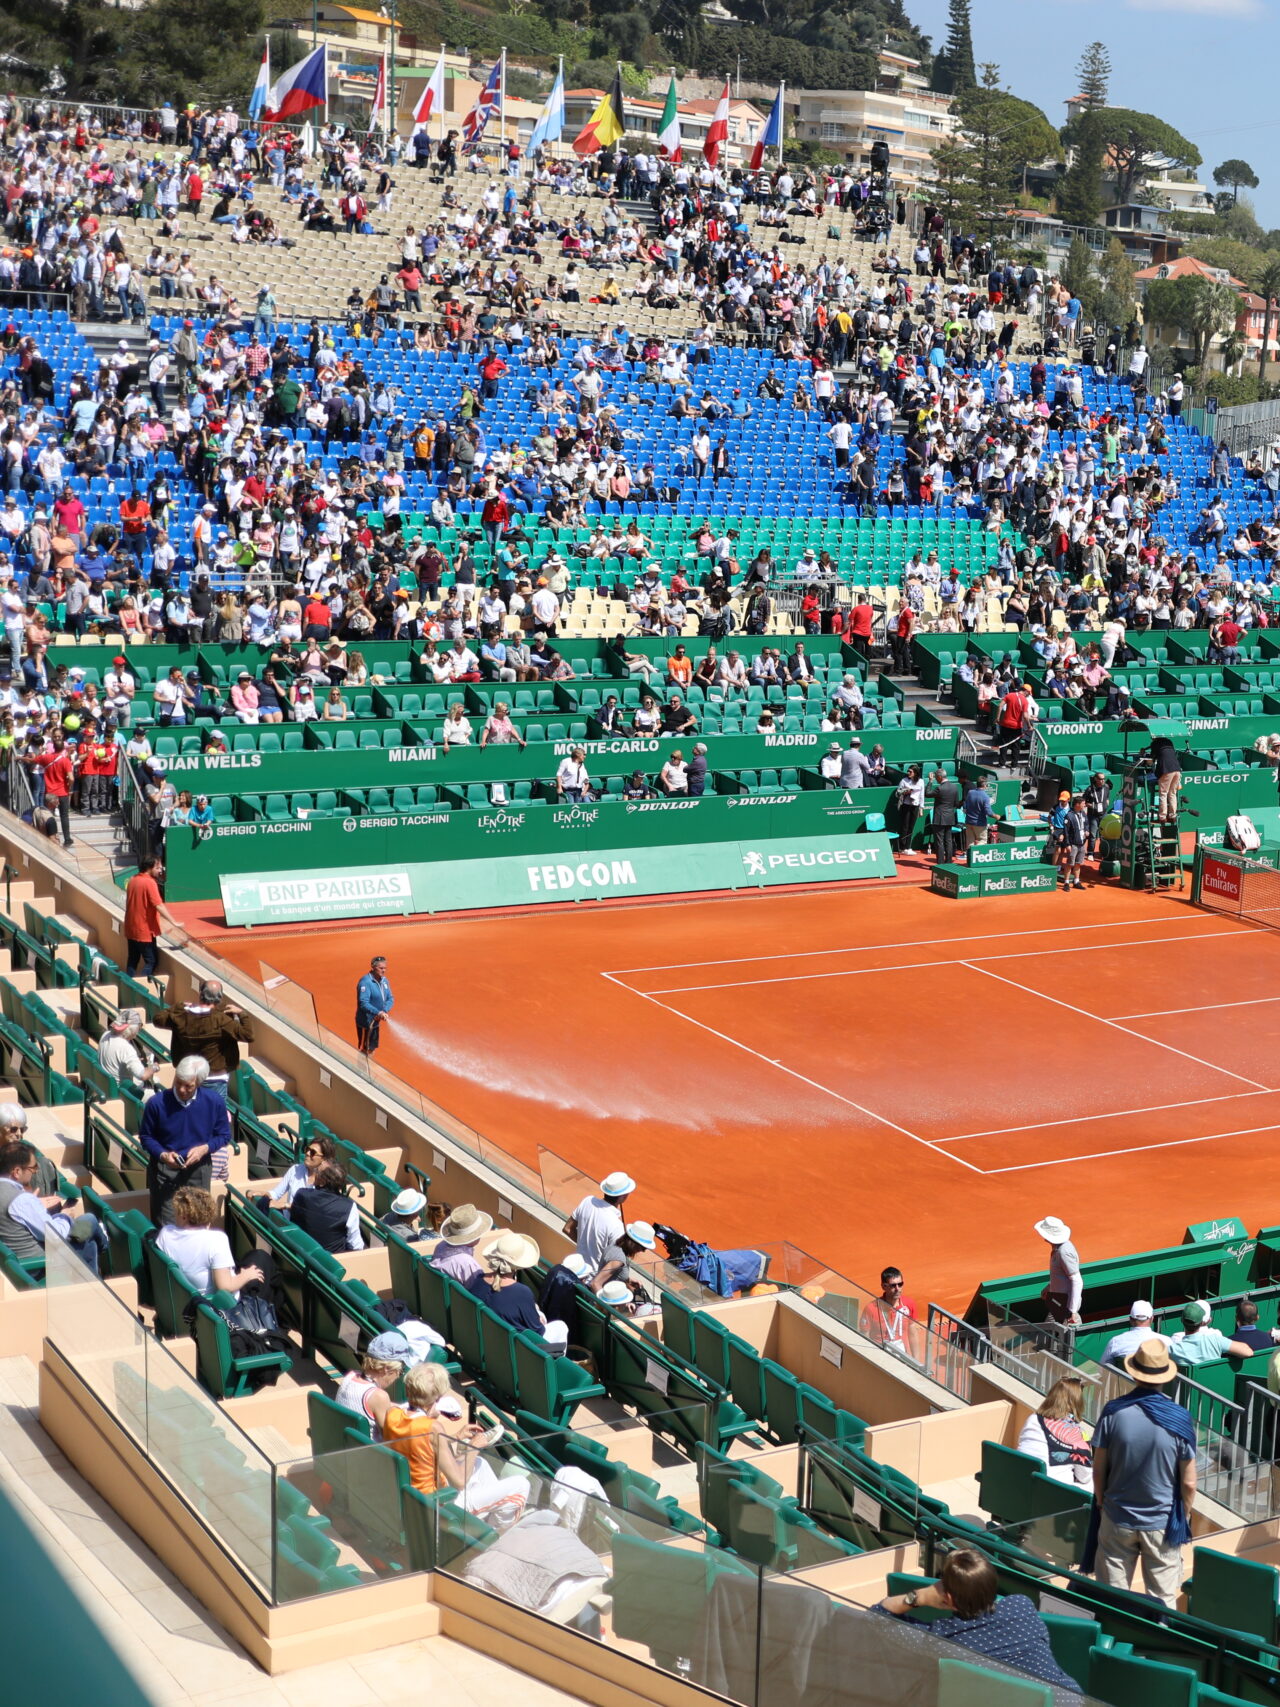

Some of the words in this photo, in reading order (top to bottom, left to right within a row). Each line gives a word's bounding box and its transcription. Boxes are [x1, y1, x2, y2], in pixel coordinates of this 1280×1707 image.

[1208, 401, 1216, 413] K
[916, 729, 953, 741] ROME
[1046, 722, 1103, 736] TORONTO
[764, 734, 818, 747] MADRID
[389, 748, 437, 762] MIAMI
[553, 740, 660, 756] MONTE-CARLO
[159, 756, 199, 771] DIAN
[204, 754, 262, 769] WELLS
[1184, 773, 1250, 785] PEUGEOT
[638, 800, 700, 812] DUNLOP
[738, 795, 798, 806] DUNLOP
[359, 816, 398, 828] SERGIO
[401, 814, 450, 826] TACCHINI
[216, 825, 257, 837] SERGIO
[260, 822, 312, 834] TACCHINI
[768, 848, 880, 869] PEUGEOT
[972, 849, 1006, 864] FedEx
[1010, 845, 1043, 861] FedEx
[527, 860, 637, 892] FEDCOM
[1217, 867, 1227, 880] Fly
[267, 883, 309, 902] BNP
[315, 877, 402, 899] PARIBAS
[984, 878, 1017, 892] FedEx
[1020, 874, 1053, 889] FedEx
[1205, 873, 1238, 894] Emirates
[282, 905, 311, 916] banque
[333, 902, 361, 911] monde
[377, 899, 405, 910] change
